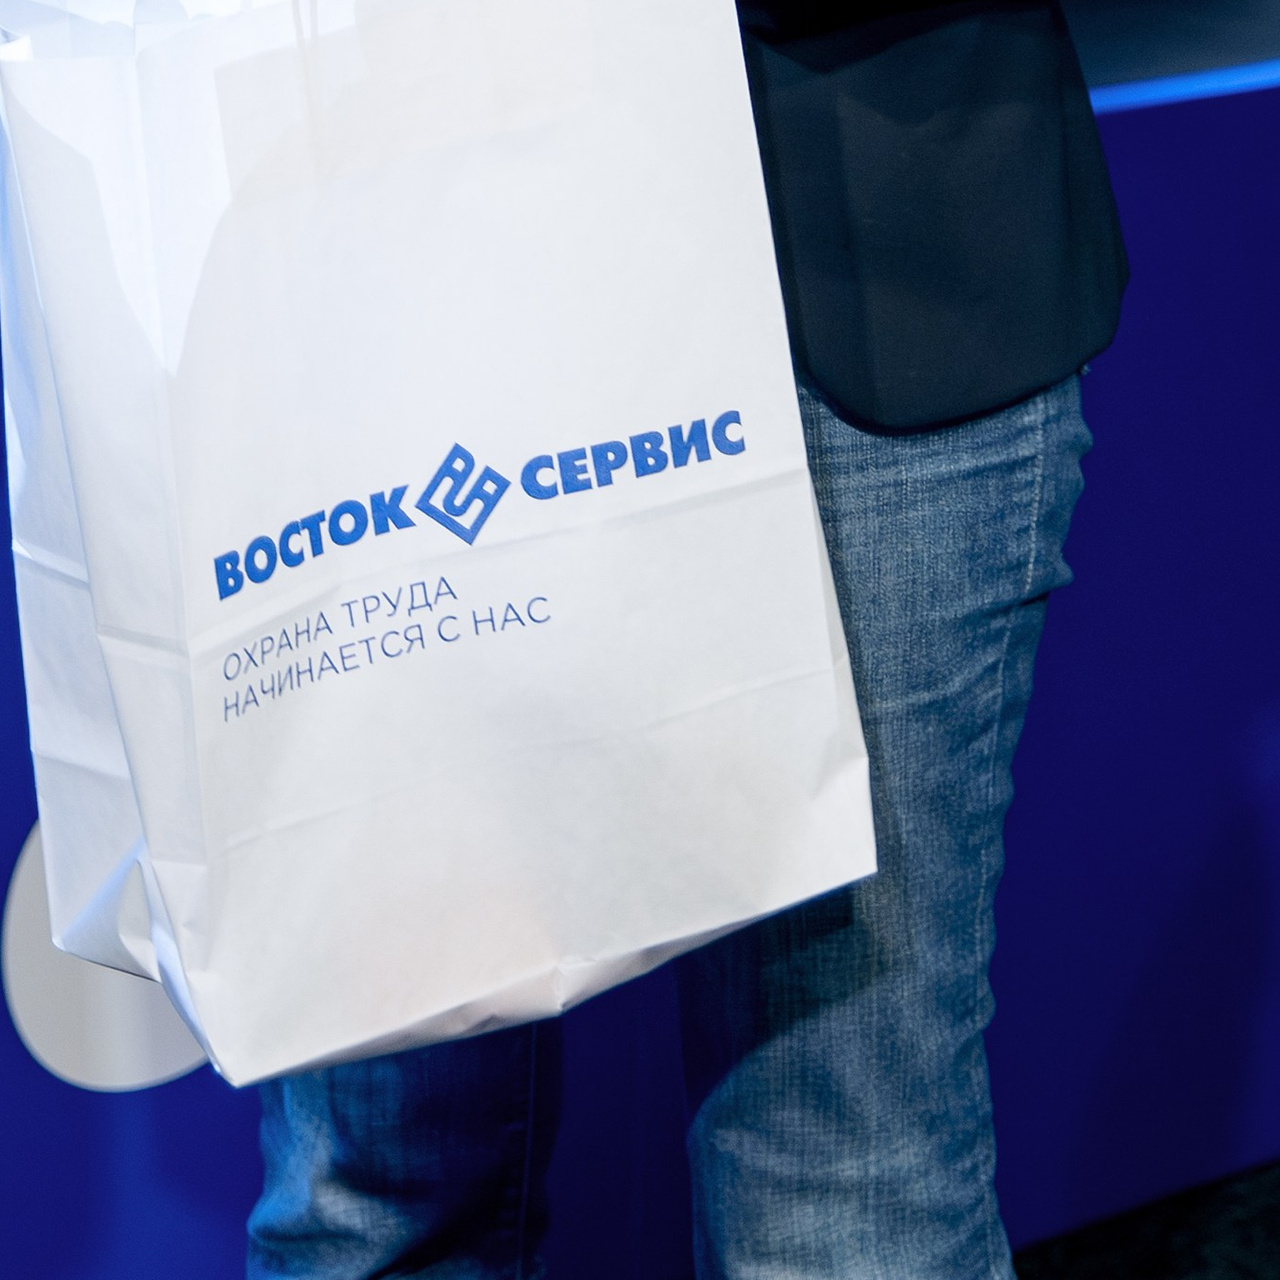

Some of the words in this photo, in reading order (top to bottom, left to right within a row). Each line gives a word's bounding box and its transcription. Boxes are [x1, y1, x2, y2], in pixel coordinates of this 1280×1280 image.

[214, 484, 416, 601] ВОСТОК
[520, 410, 746, 501] СЕРВИС
[223, 611, 333, 681] ОХРАНА
[340, 576, 458, 627] ТРУДА
[223, 624, 426, 722] НАЧИНАЕТСЯ
[437, 615, 461, 643] С
[472, 596, 552, 638] НАС
